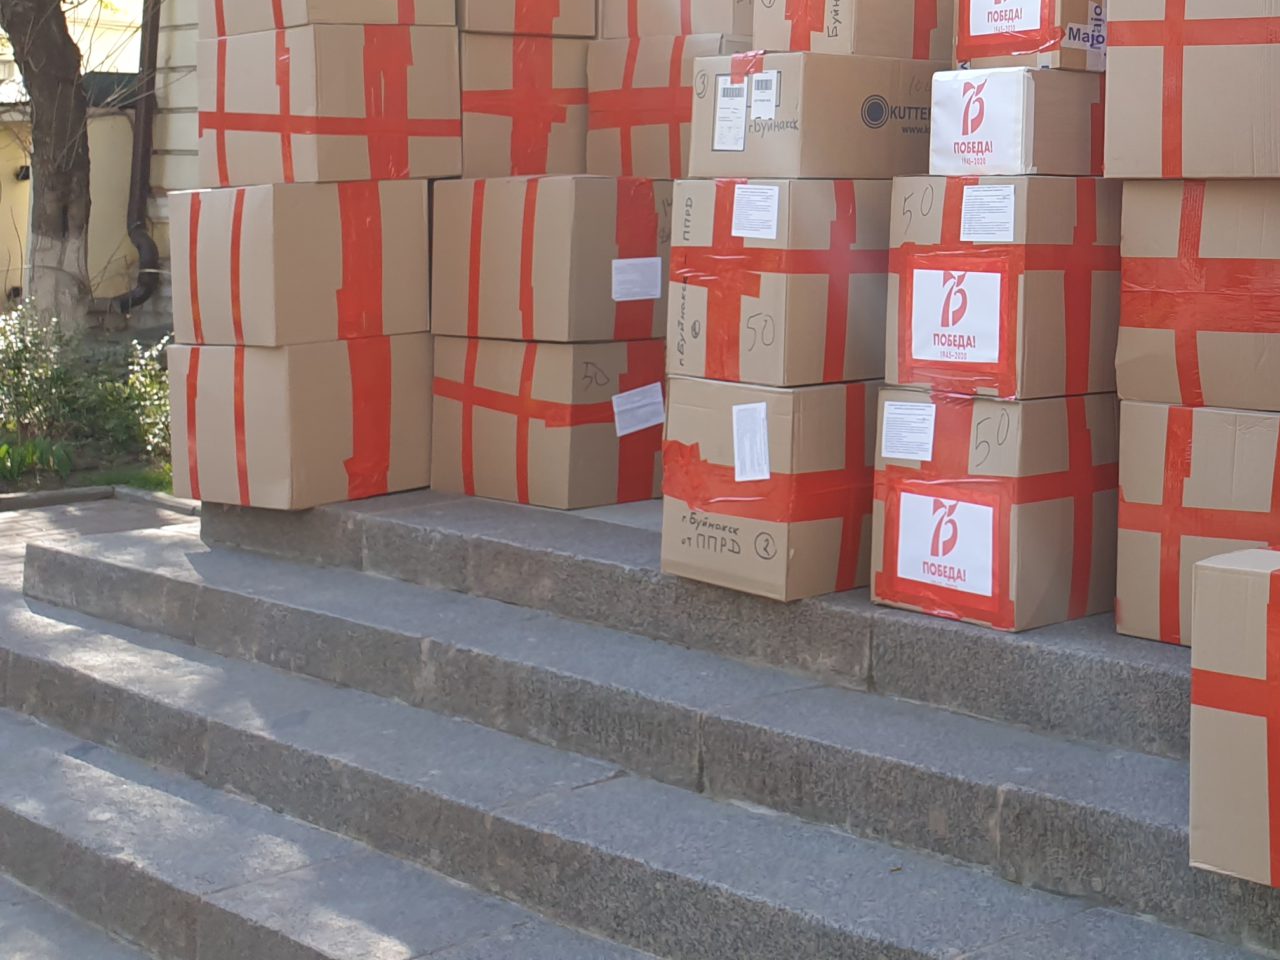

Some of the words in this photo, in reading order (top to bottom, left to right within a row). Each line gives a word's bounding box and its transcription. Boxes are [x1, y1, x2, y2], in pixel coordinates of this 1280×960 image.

[987, 7, 1023, 24] ПОБЕДА!
[954, 141, 993, 157] ПОБЕДА!
[902, 183, 934, 235] 50
[746, 312, 776, 352] 50
[933, 333, 976, 351] ПОБЕДА!
[975, 407, 1010, 467] 50
[689, 511, 740, 535] Буйнакск
[922, 561, 967, 583] ПОБЕДА!
